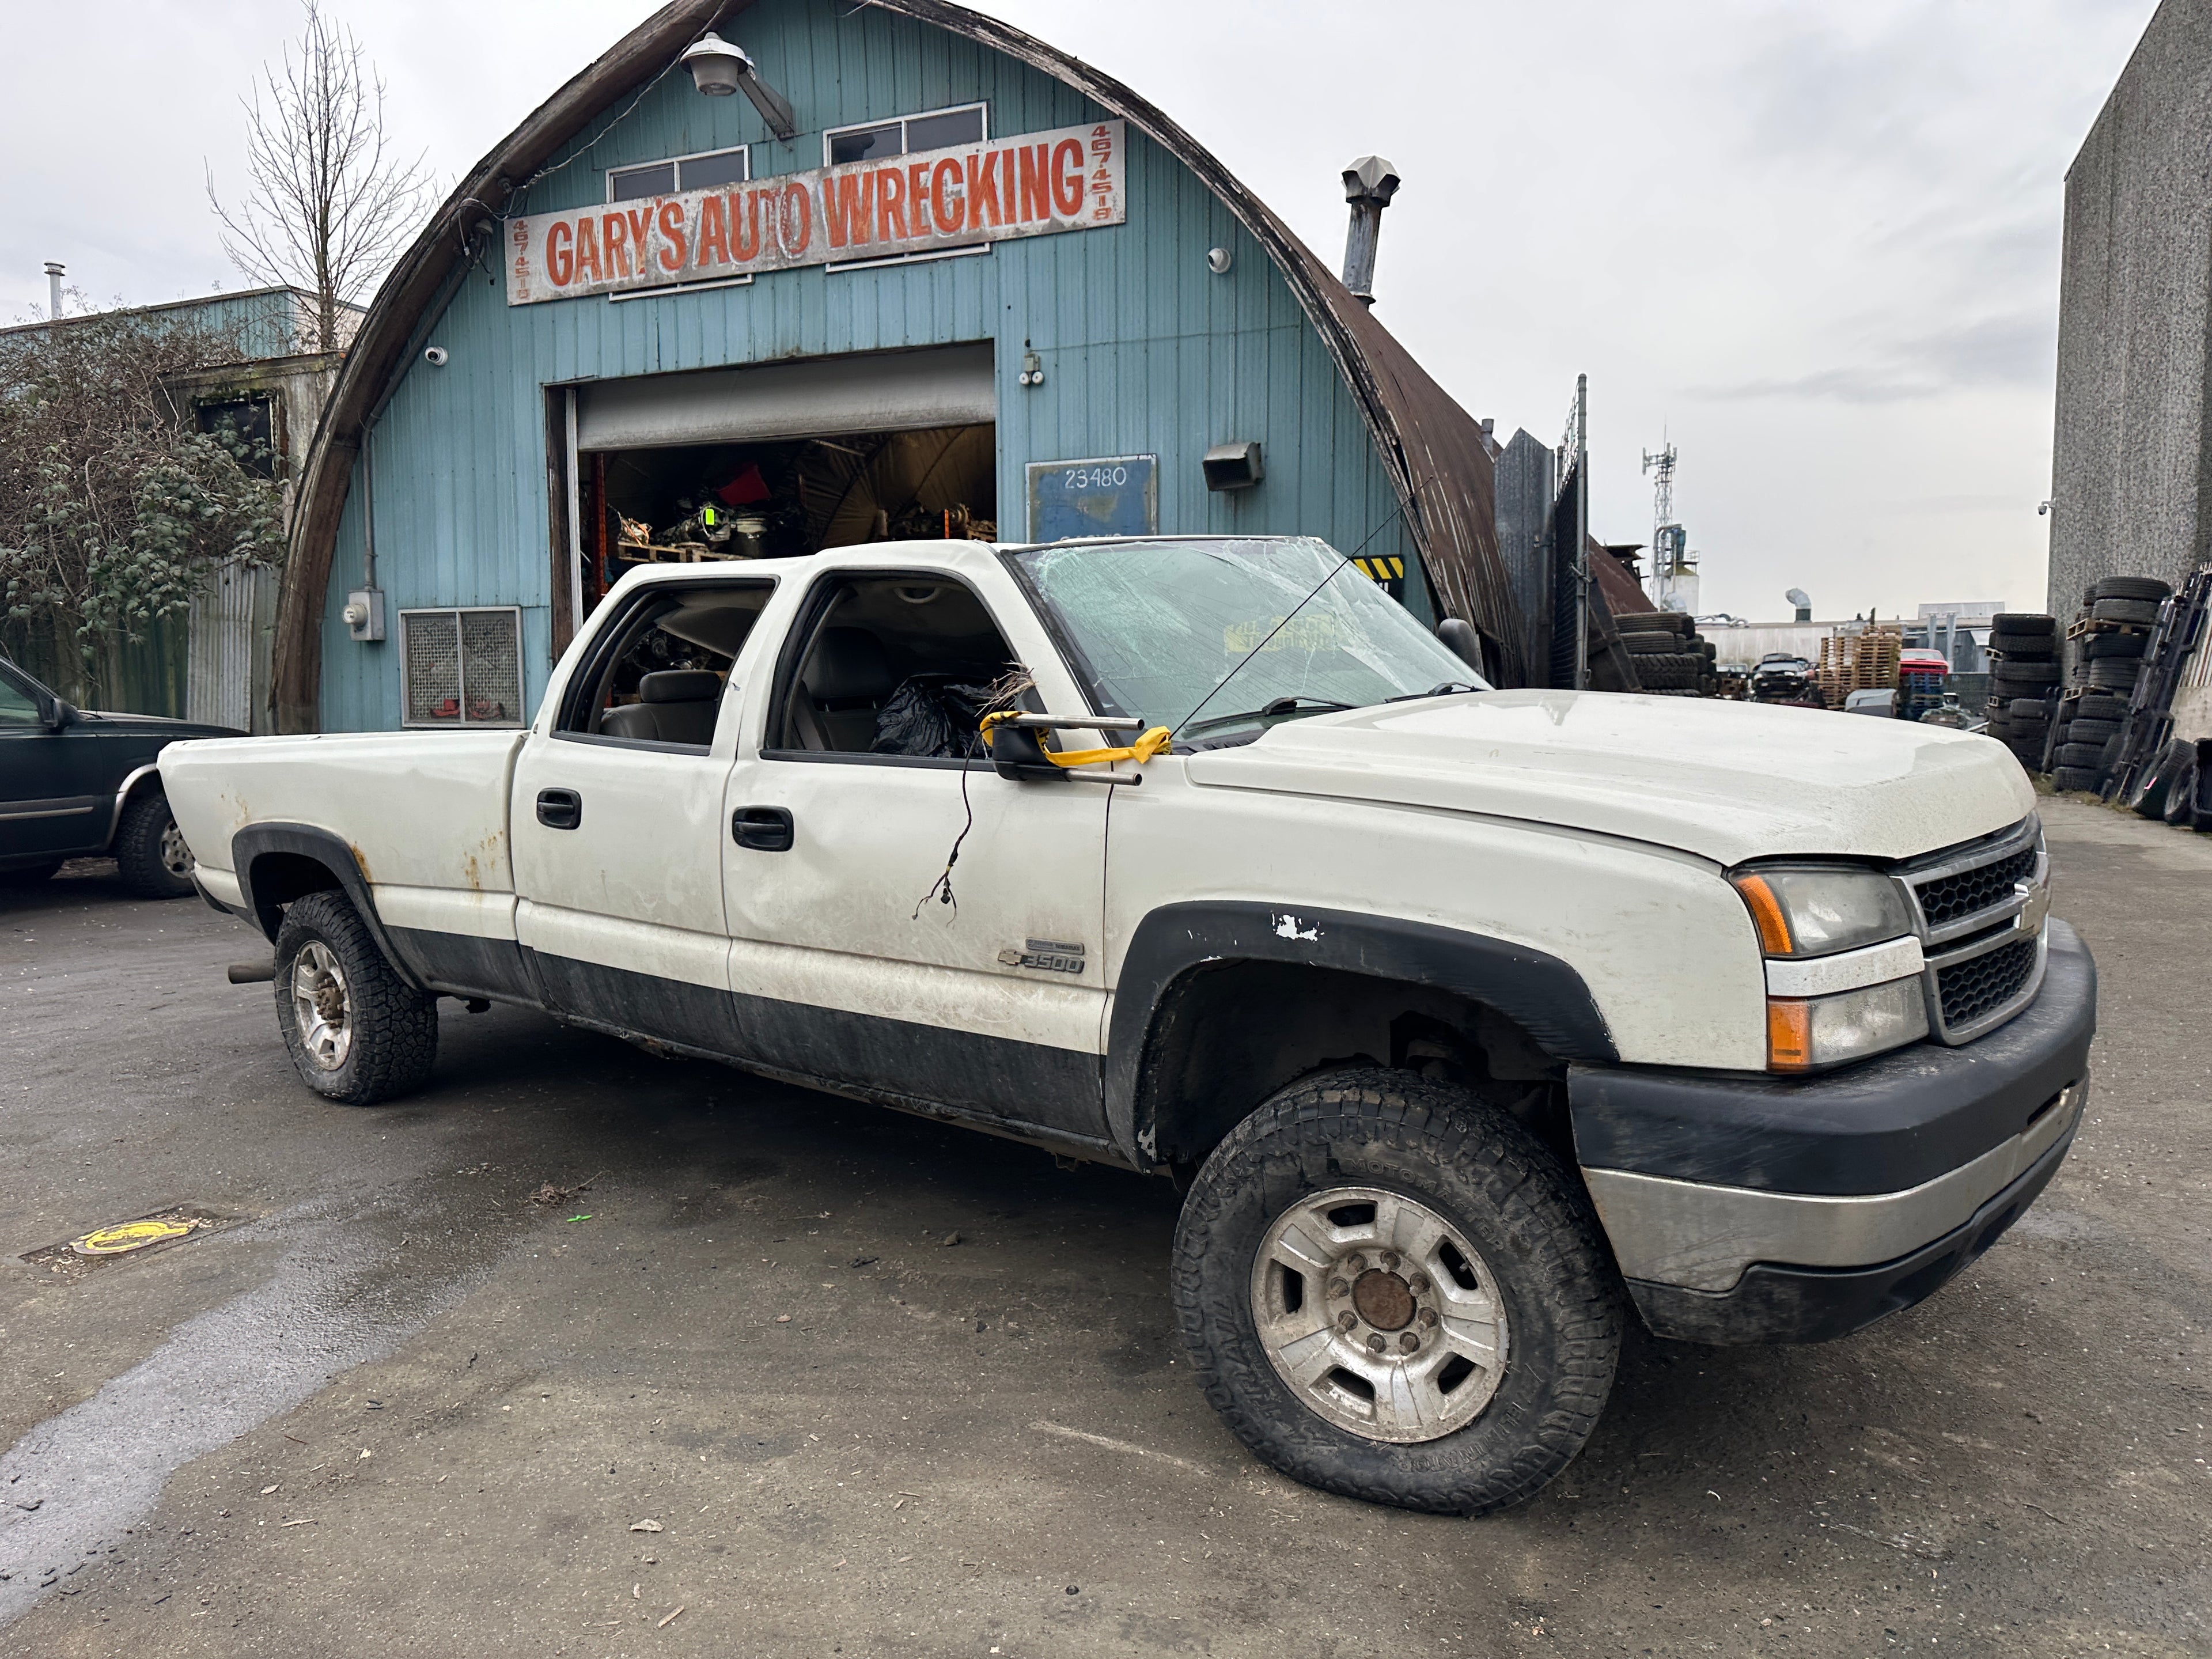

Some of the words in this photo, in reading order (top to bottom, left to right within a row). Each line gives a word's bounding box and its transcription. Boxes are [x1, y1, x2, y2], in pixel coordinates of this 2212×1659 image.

[546, 198, 687, 287] GARY'S
[698, 182, 811, 267] AUTO
[823, 138, 1084, 248] WRECKING
[1065, 467, 1127, 489] 23480
[1024, 954, 1085, 974] 3500
